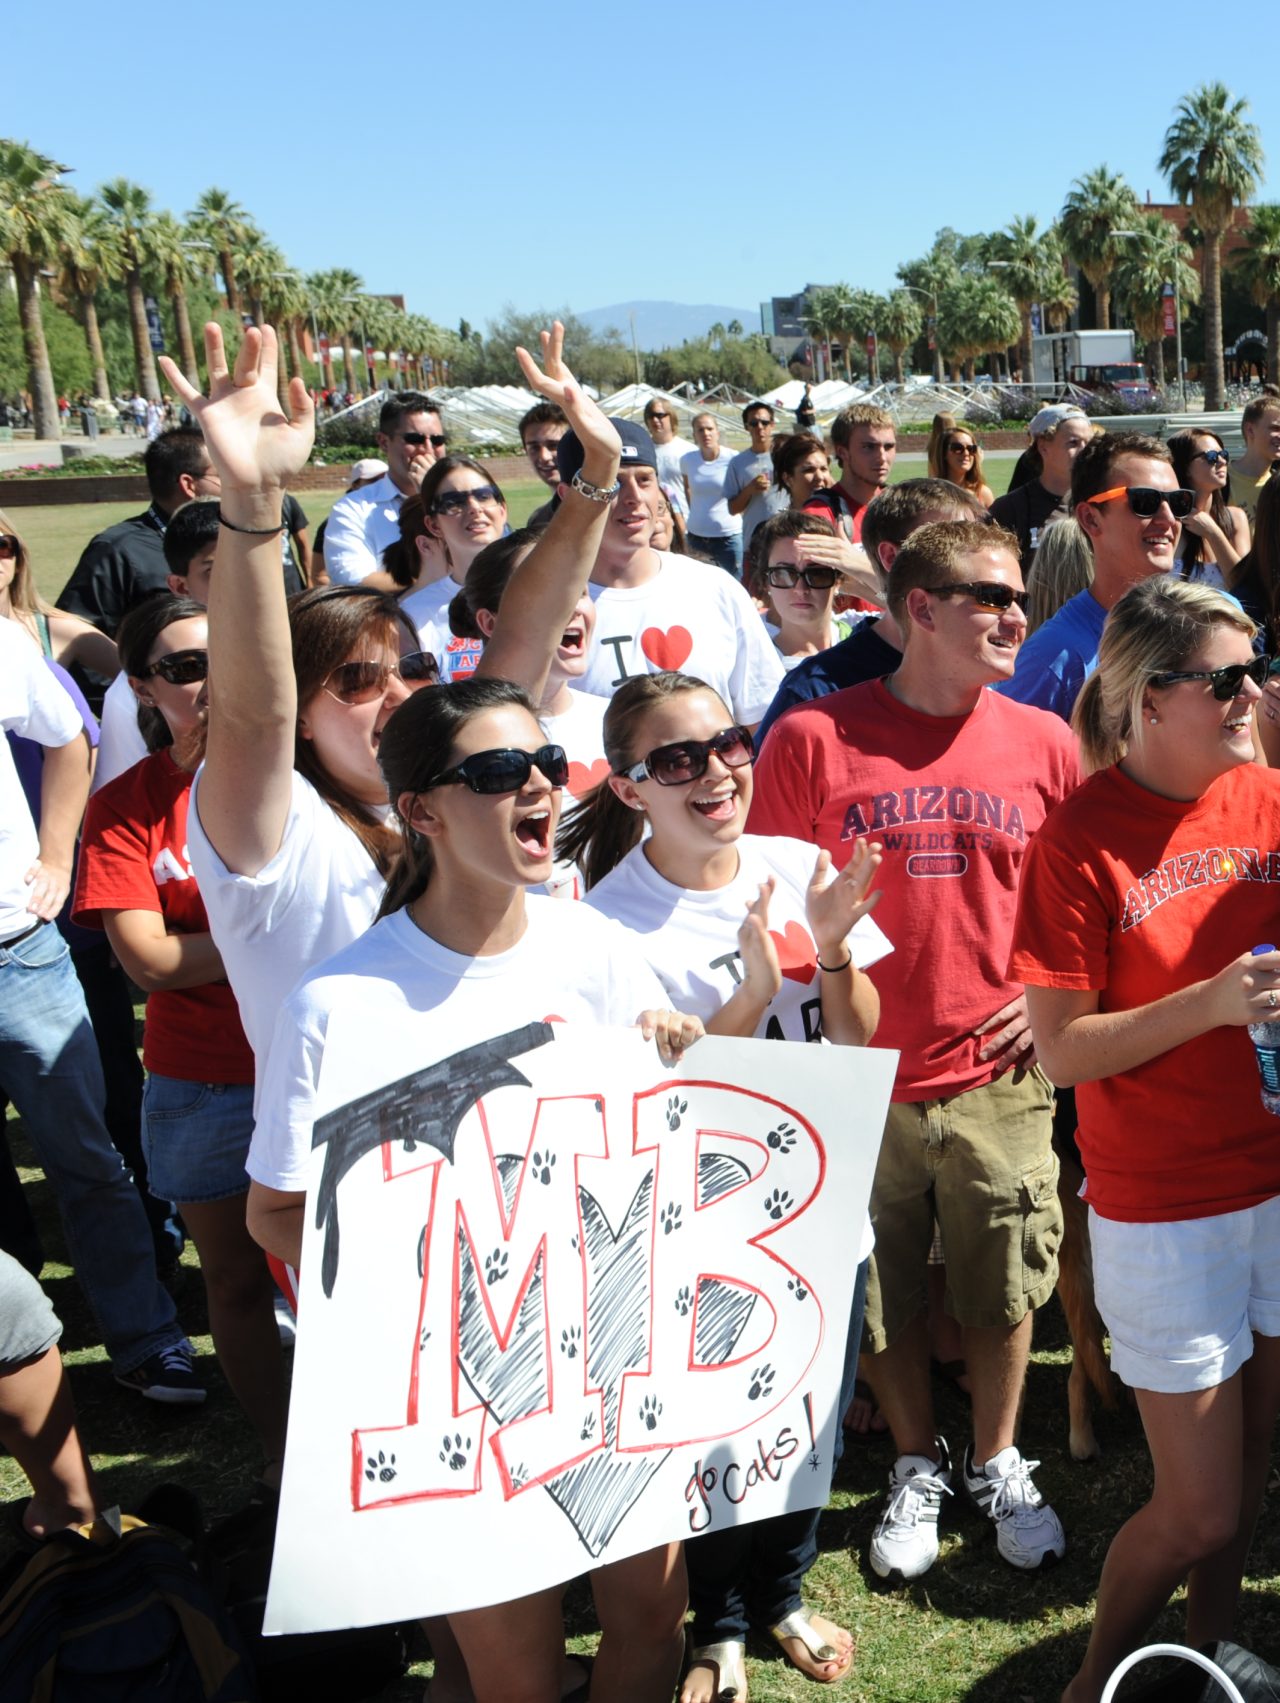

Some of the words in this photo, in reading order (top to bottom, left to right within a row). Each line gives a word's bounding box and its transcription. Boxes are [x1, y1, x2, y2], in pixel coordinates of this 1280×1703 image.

[601, 635, 632, 687] I
[840, 786, 1026, 846] ARIZONA
[882, 832, 993, 851] WILDCATS
